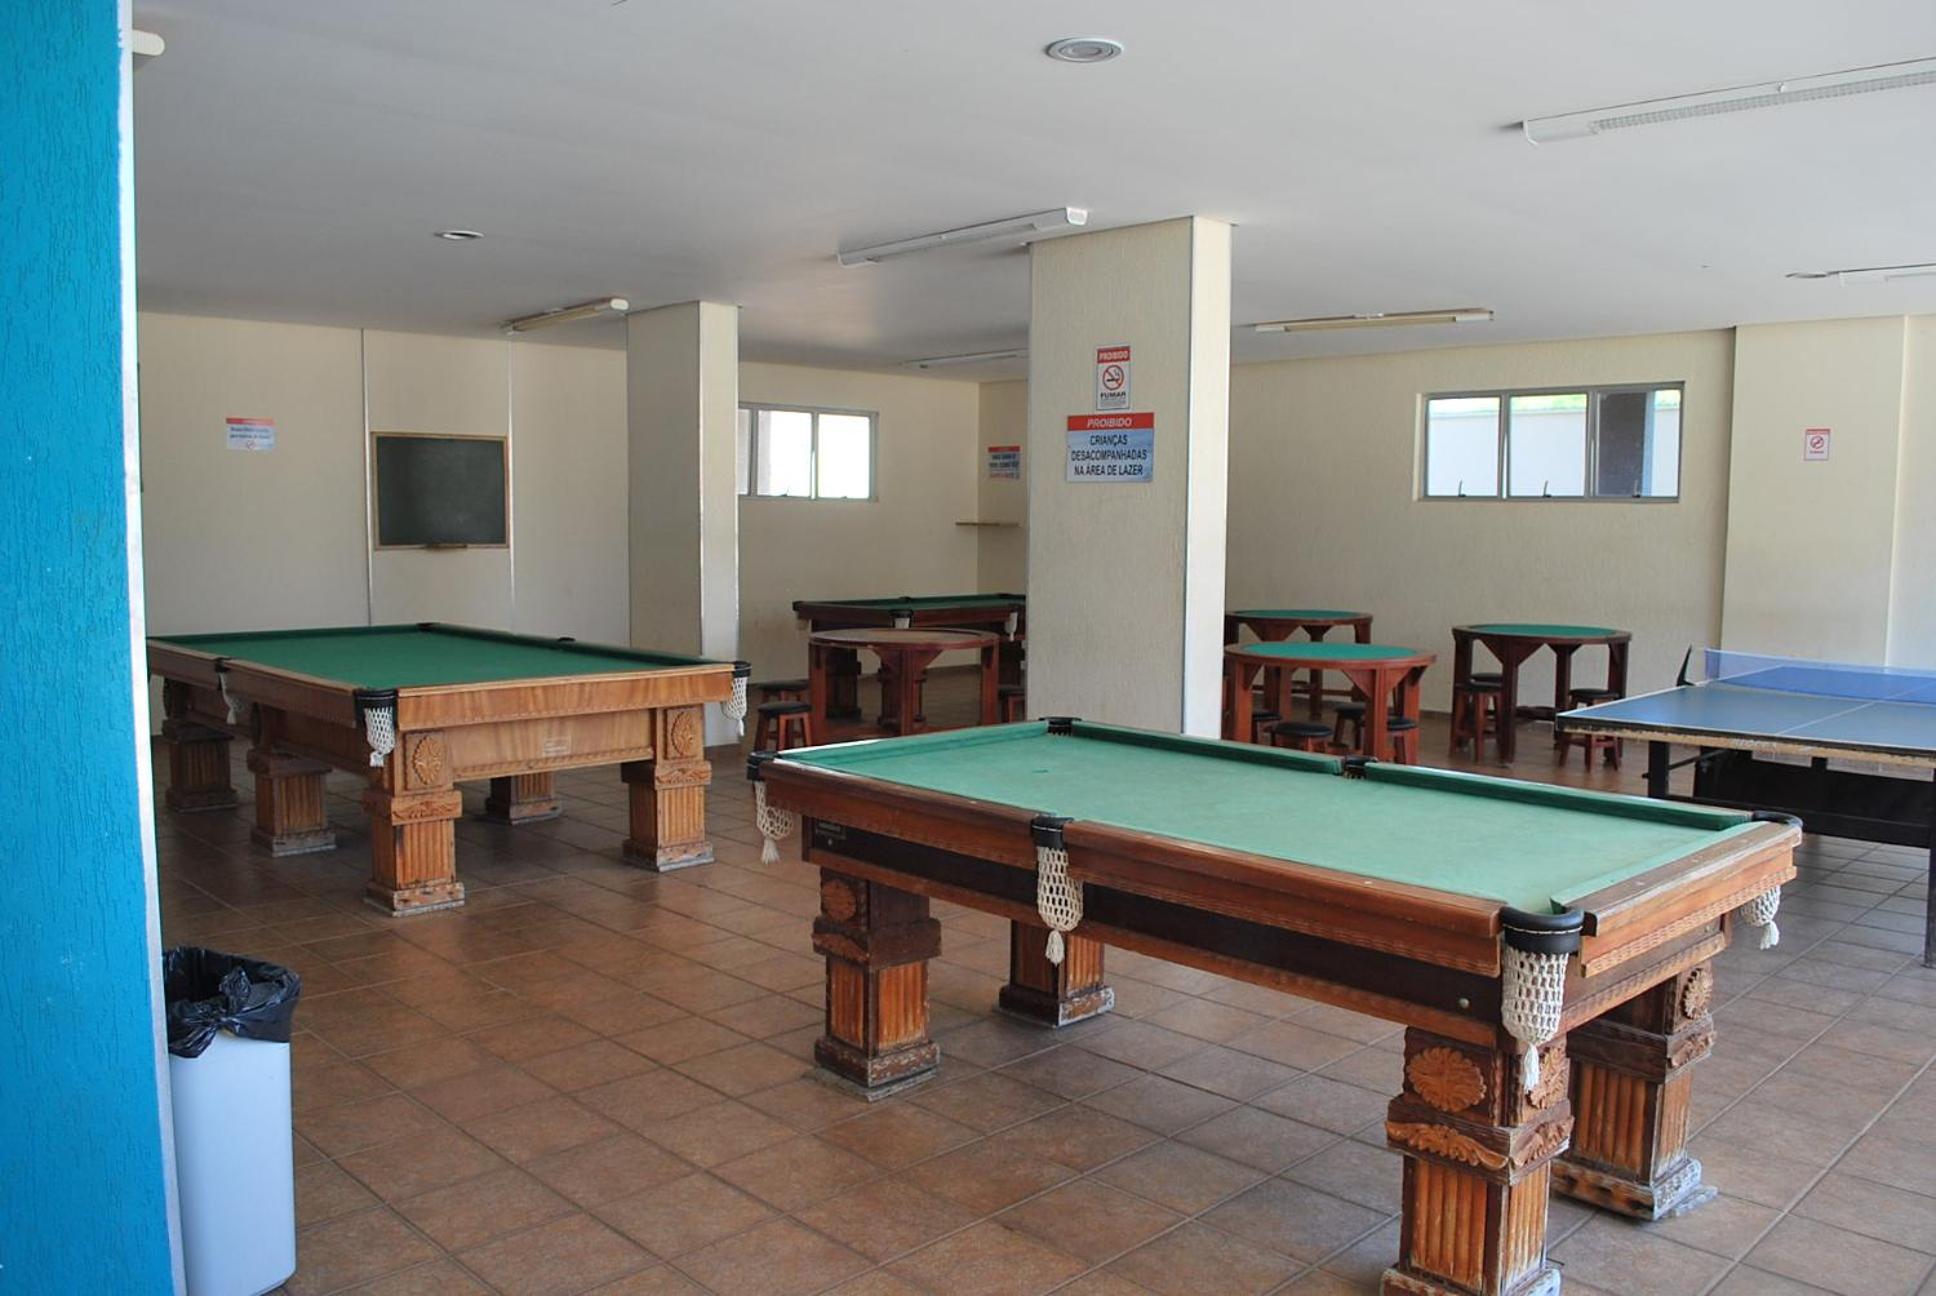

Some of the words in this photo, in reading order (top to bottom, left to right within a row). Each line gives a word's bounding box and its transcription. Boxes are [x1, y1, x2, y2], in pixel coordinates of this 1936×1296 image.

[1087, 417, 1132, 428] PROIBIDO
[1090, 434, 1128, 447] CRIANÇAS
[1071, 449, 1147, 461] DESACOMPANHADAS
[1074, 465, 1084, 476] NA
[1107, 464, 1117, 476] DE
[1119, 464, 1143, 476] LAZER
